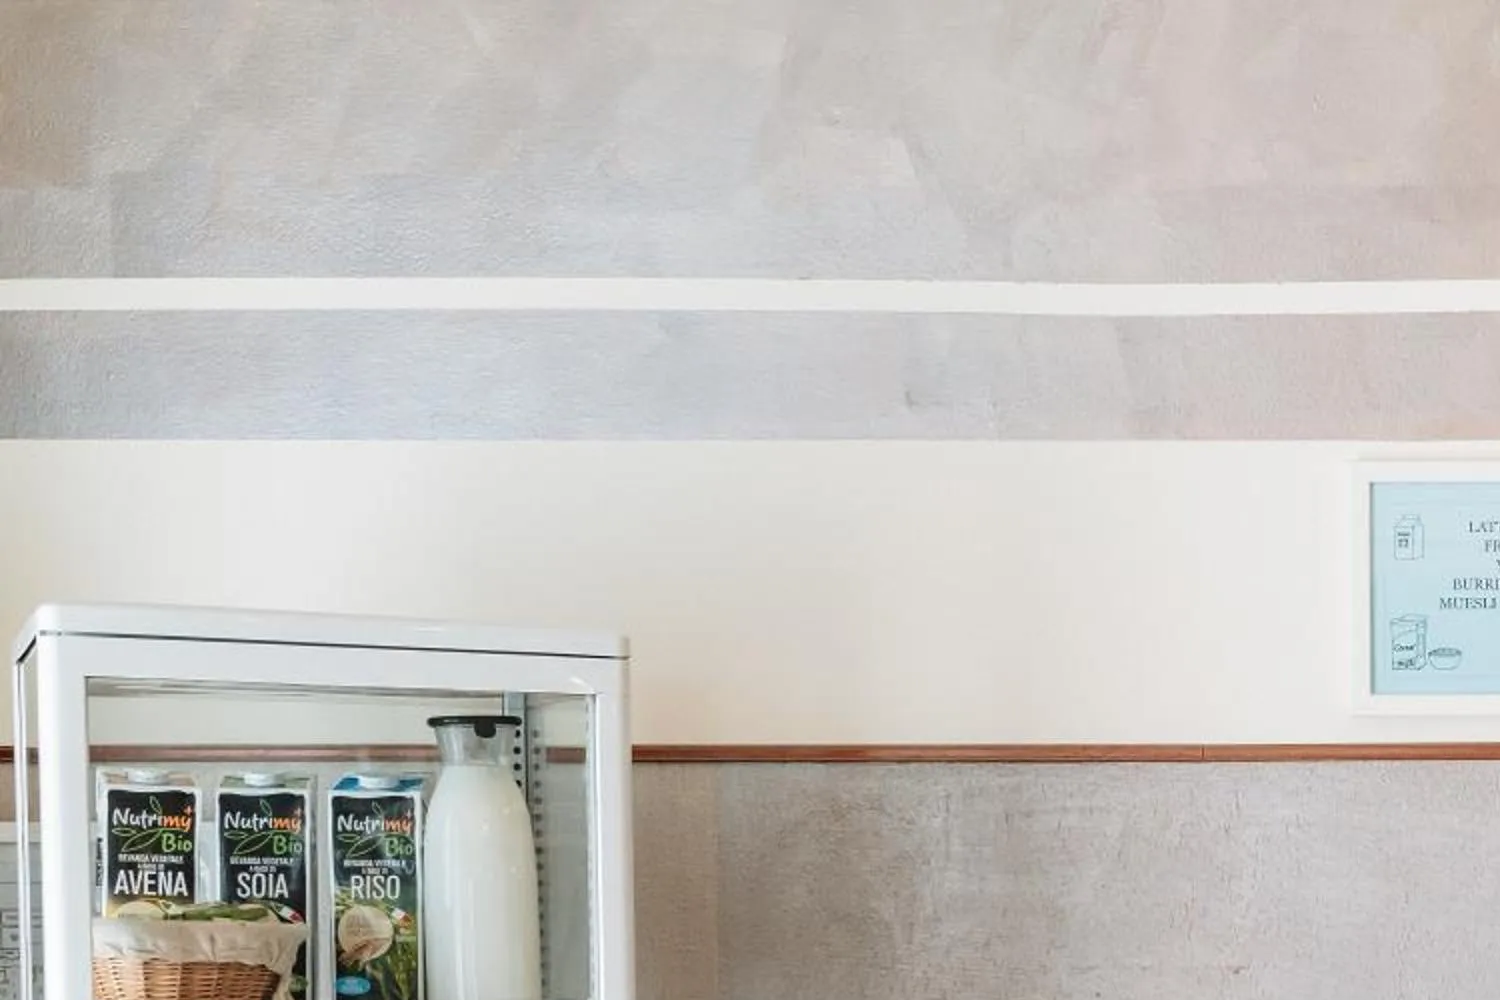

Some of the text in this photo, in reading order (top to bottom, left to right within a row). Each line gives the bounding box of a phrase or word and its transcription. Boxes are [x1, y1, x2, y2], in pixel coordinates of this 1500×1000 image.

[161, 832, 192, 852] Bio
[273, 834, 302, 854] Bio
[385, 837, 413, 856] Bio
[114, 869, 188, 896] AVENA
[236, 872, 288, 899] SOIA
[350, 875, 401, 899] RISO
